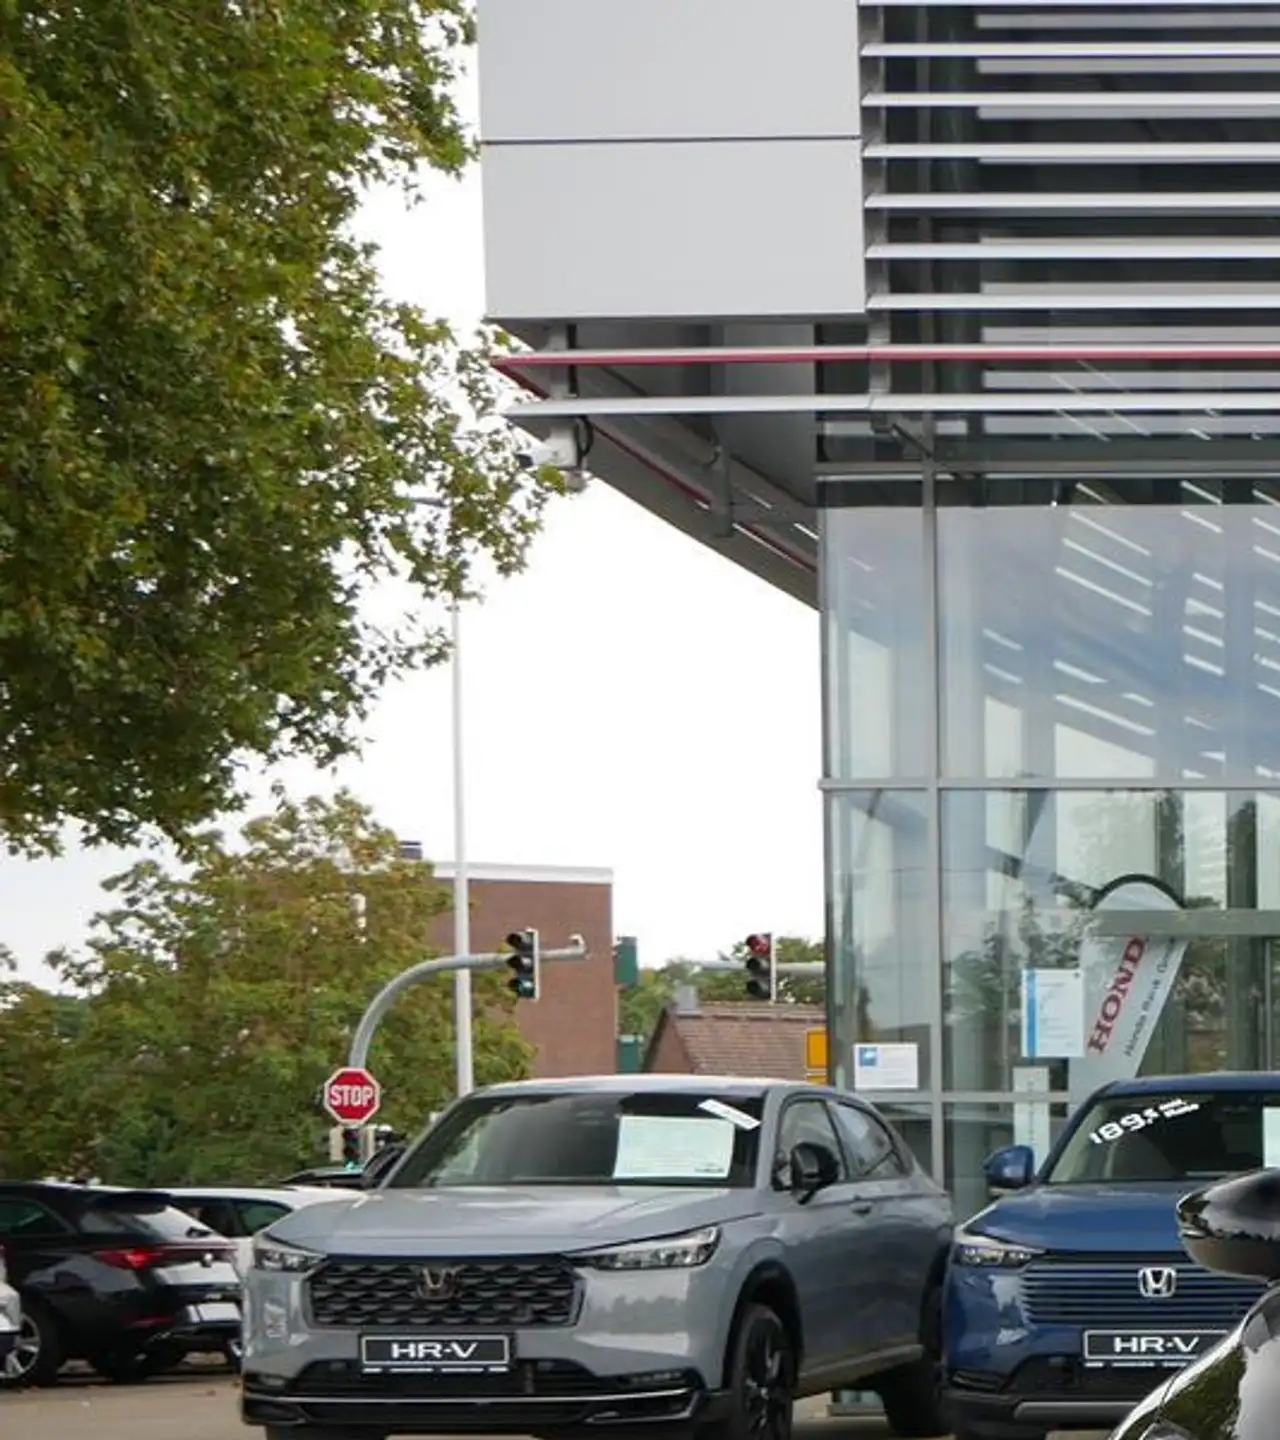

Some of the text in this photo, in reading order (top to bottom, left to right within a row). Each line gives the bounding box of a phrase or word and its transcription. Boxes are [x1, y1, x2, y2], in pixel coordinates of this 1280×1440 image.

[1087, 936, 1148, 1053] HOND
[330, 1085, 373, 1106] STOP
[391, 1342, 478, 1358] HR-V
[1114, 1336, 1199, 1352] HR-V
